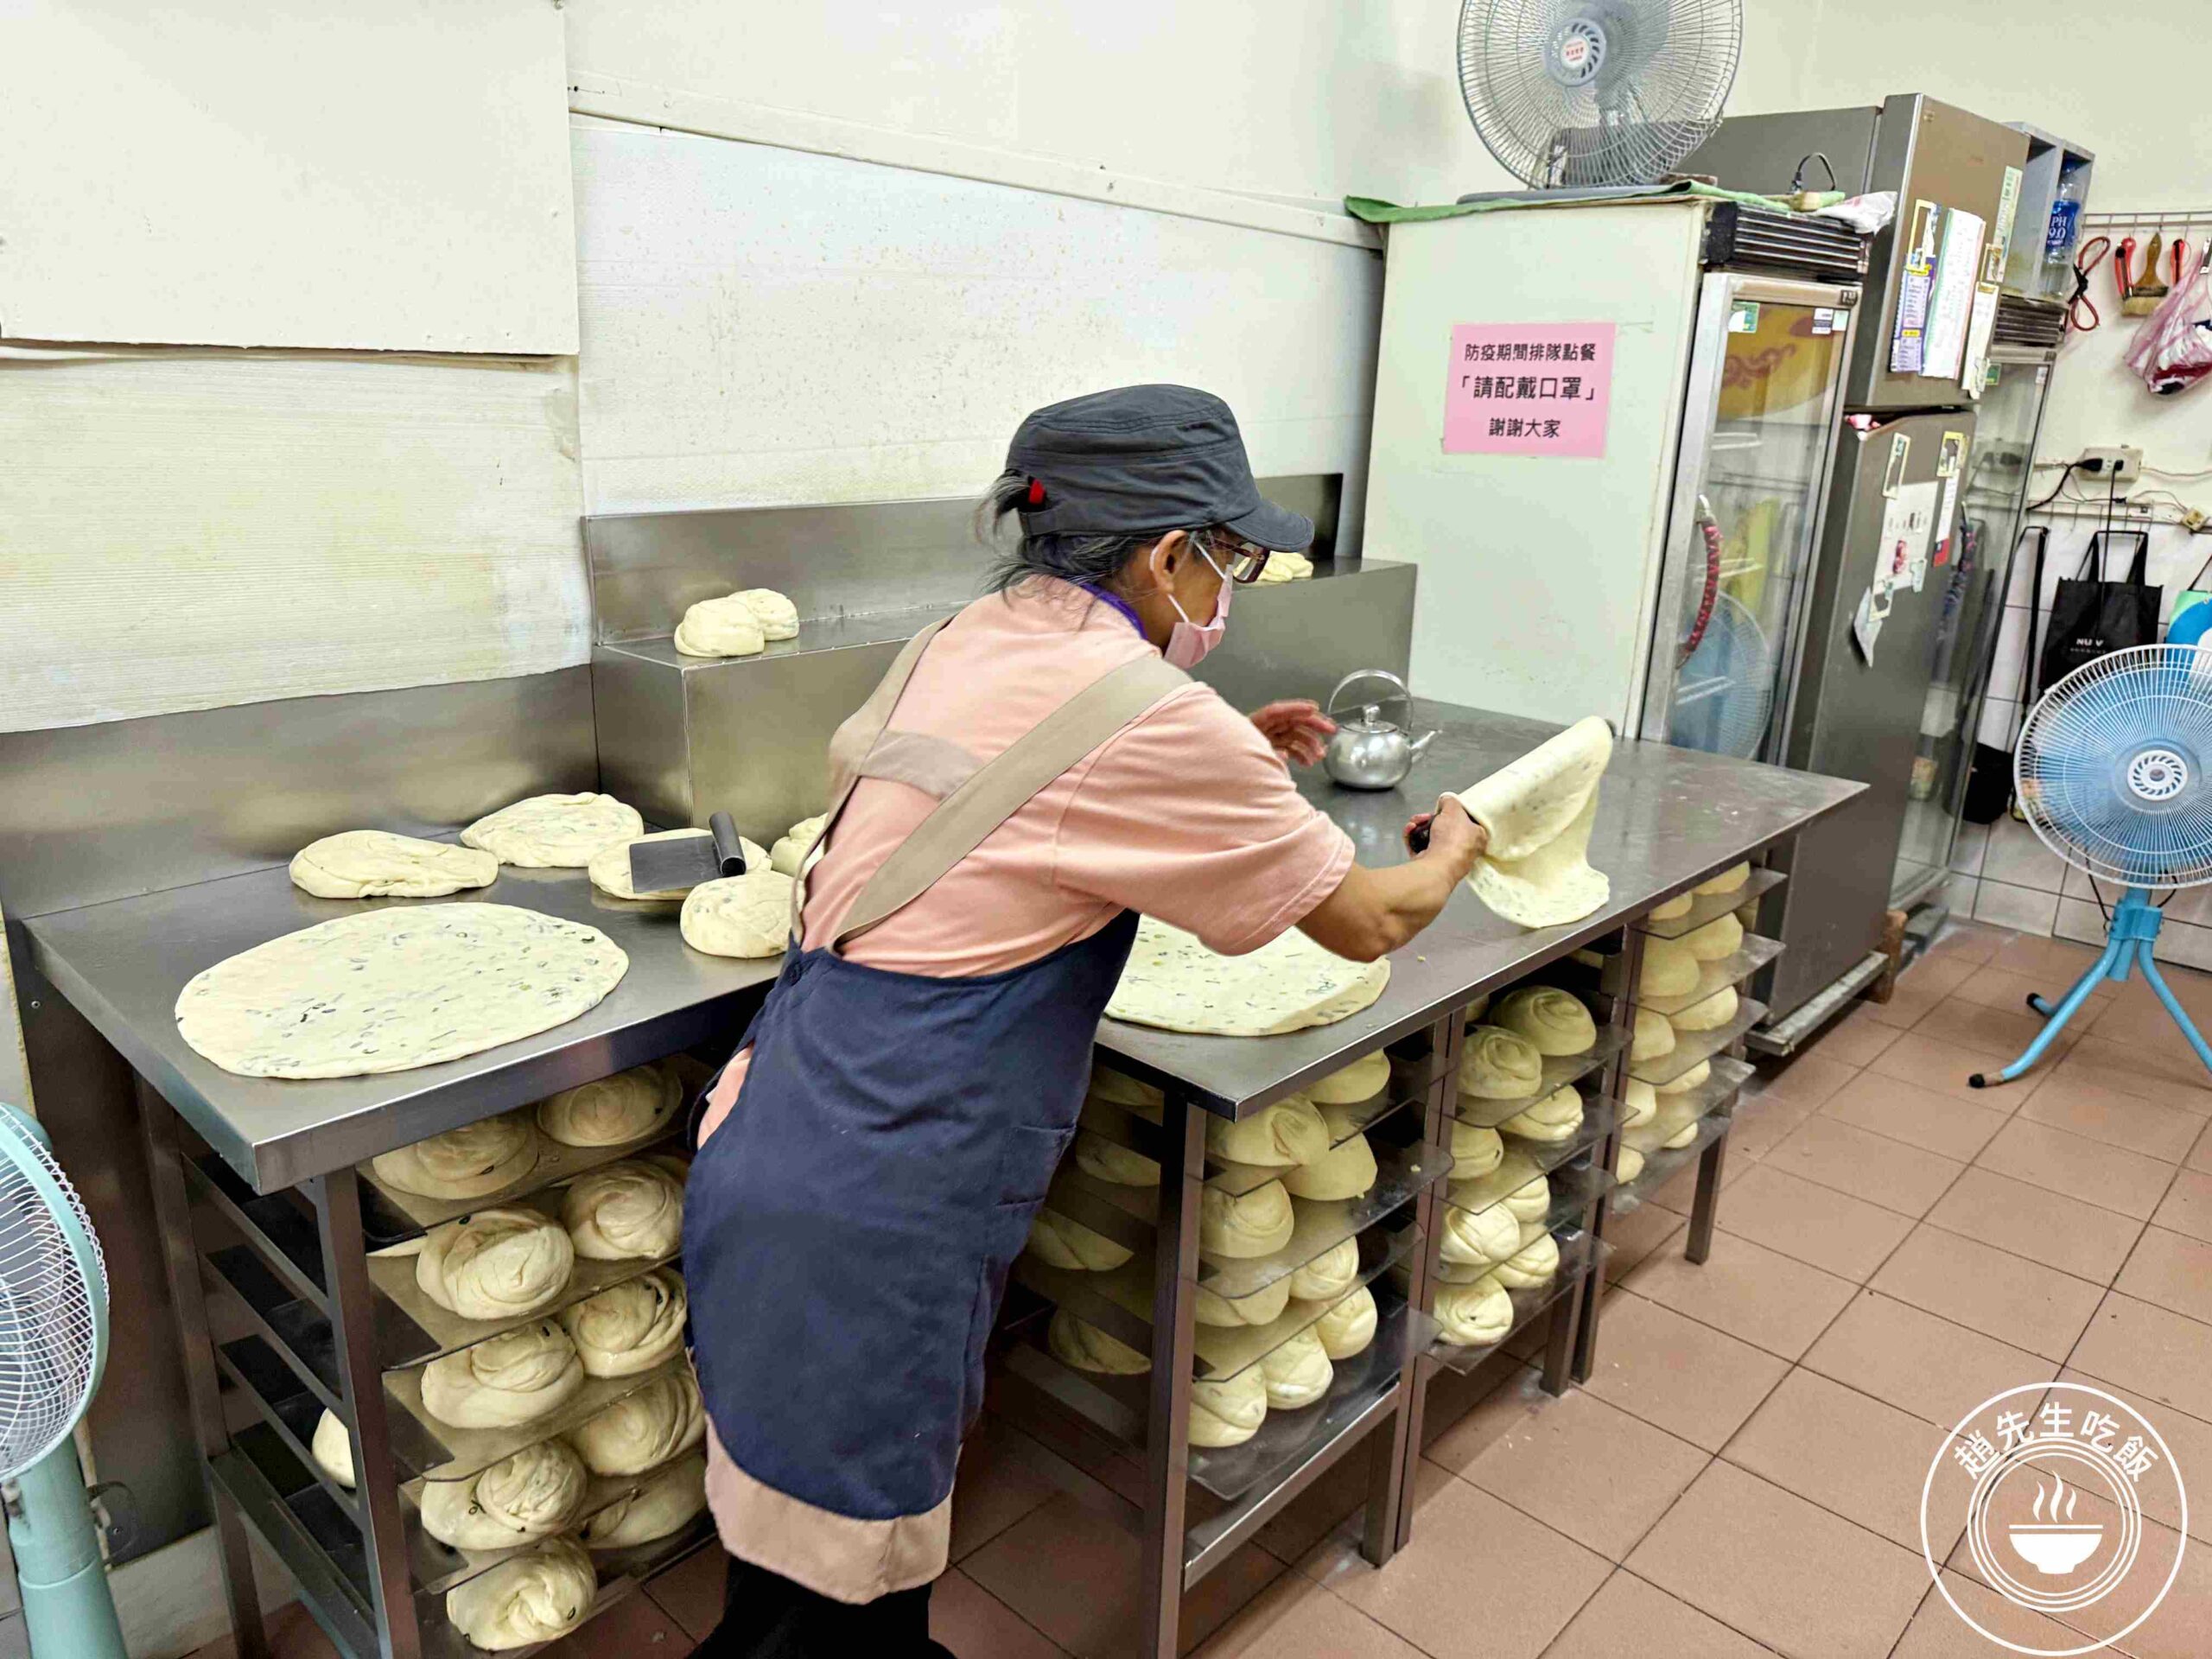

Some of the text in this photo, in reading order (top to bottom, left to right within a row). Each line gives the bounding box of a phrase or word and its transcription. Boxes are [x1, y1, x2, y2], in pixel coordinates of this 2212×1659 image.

[2051, 216, 2067, 227] PH
[1465, 343, 1597, 361] 防疫期間排隊點餐
[1461, 376, 1595, 401] 「請配戴口罩」
[1488, 417, 1560, 438] 謝謝大家
